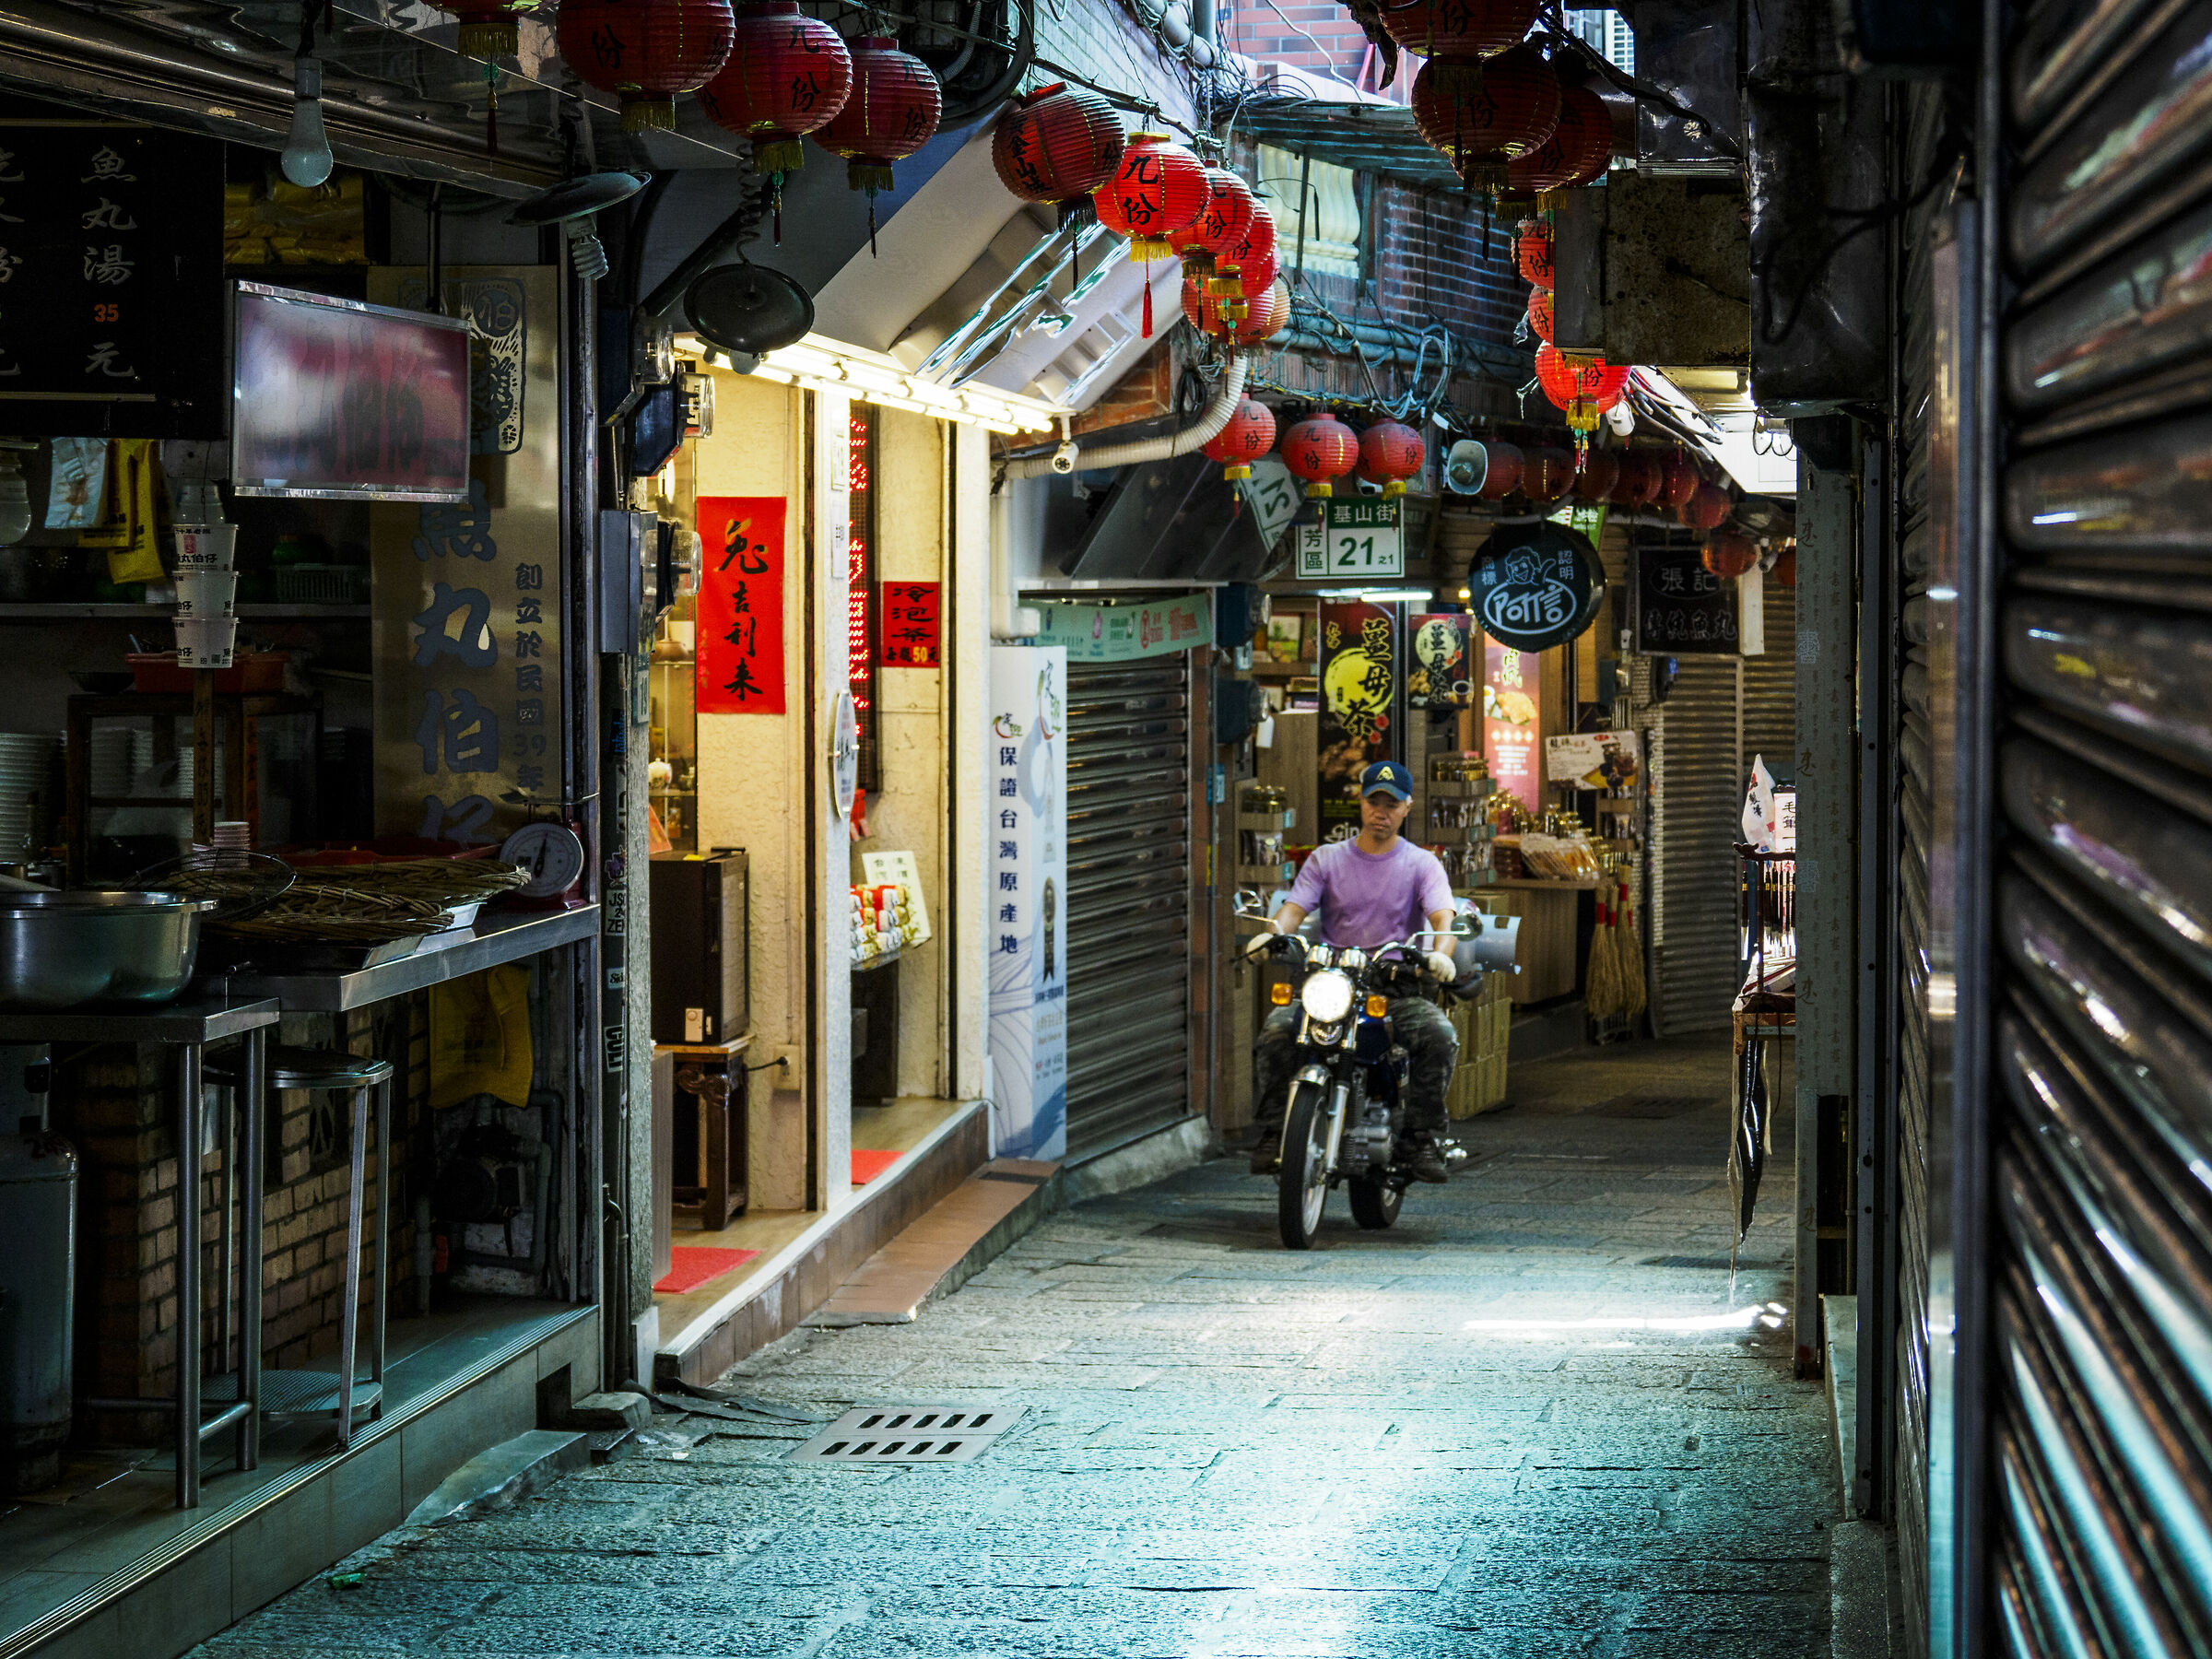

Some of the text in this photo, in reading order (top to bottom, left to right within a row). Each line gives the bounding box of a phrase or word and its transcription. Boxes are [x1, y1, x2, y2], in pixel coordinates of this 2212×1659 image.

[790, 24, 820, 113] 九份
[1122, 154, 1159, 226] 九份
[80, 145, 138, 377] 魚丸湯 35 元
[1241, 405, 1261, 451] 九份
[1304, 426, 1322, 470] 九份
[1333, 504, 1394, 524] 基山街
[1304, 530, 1324, 570] 芳區
[1337, 536, 1373, 566] 21
[1661, 567, 1716, 593] 張記
[891, 586, 935, 642] 冷泡茶
[1342, 618, 1393, 737] 薑母茶
[999, 746, 1018, 955] 保證台灣原產地
